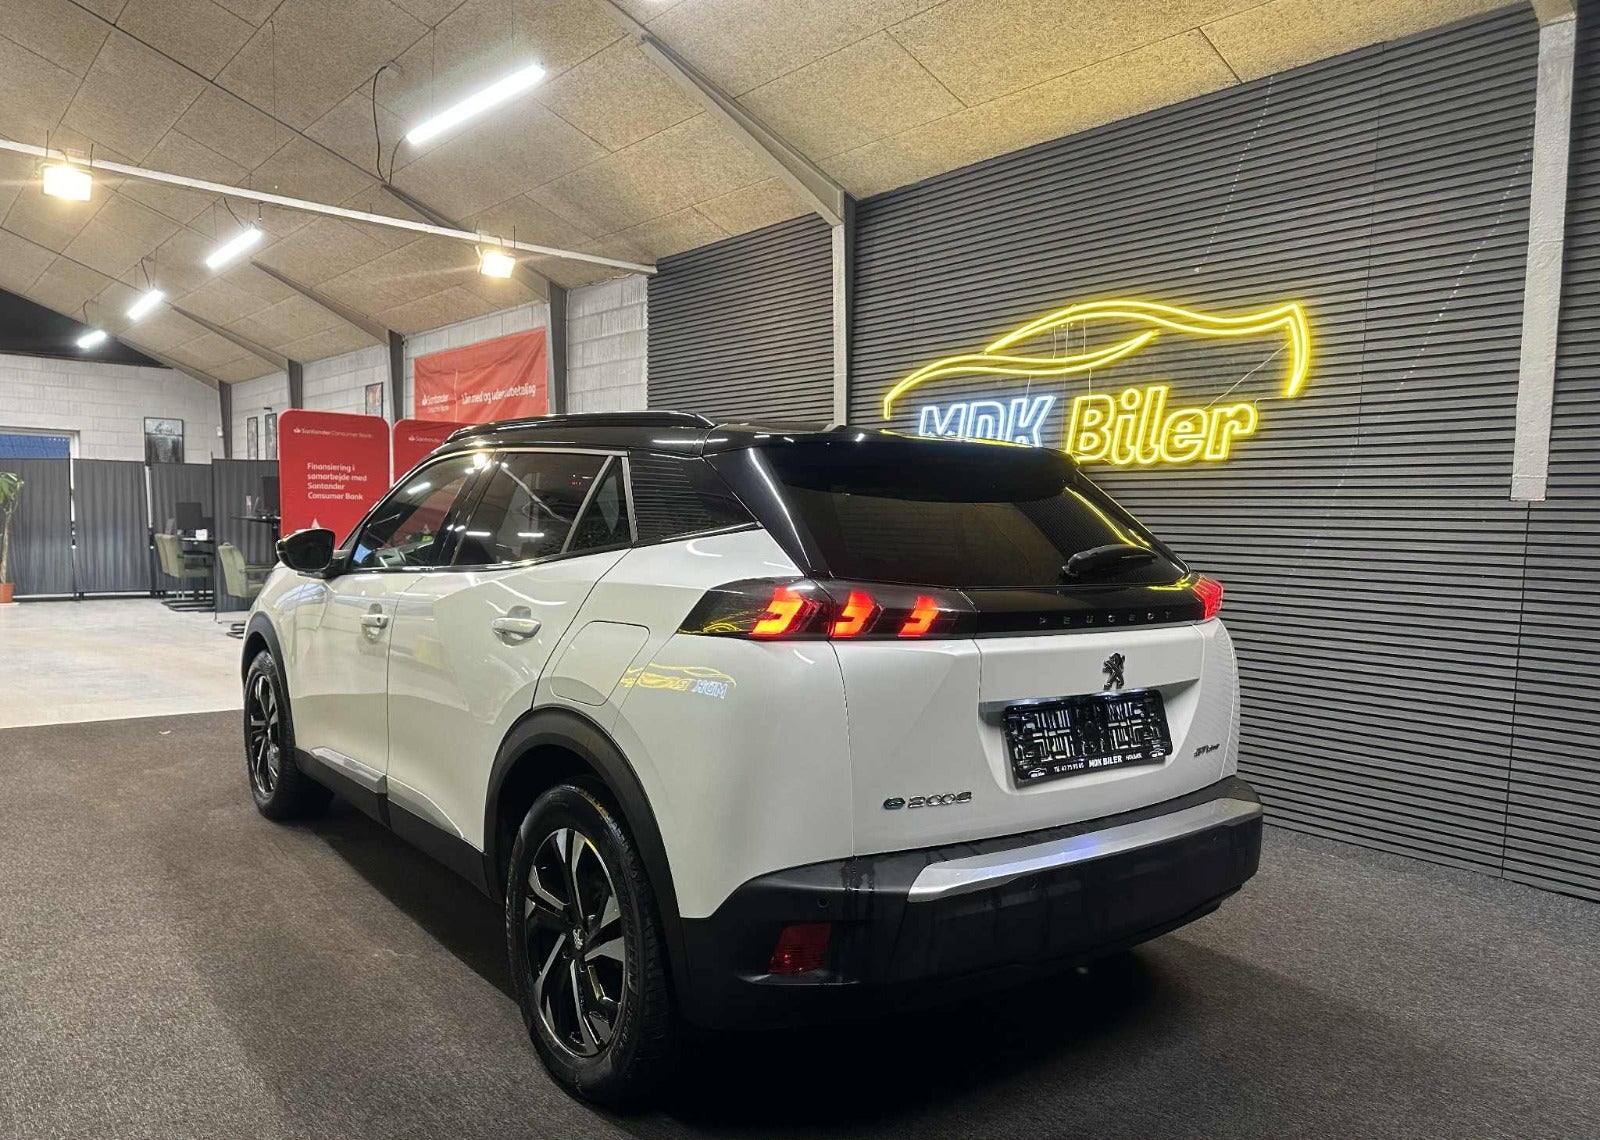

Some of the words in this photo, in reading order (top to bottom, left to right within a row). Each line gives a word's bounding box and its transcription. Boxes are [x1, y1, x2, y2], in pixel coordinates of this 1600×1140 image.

[483, 391, 492, 404] og
[918, 395, 1055, 448] MDK
[1066, 385, 1260, 466] Biler
[301, 427, 331, 435] Santander
[331, 430, 358, 438] Consumer
[307, 462, 351, 473] Finansiering
[307, 473, 350, 482] samarbejde
[307, 482, 345, 490] Santander
[307, 491, 344, 500] Consumer
[345, 492, 363, 500] Bank
[1038, 611, 1172, 625] PEUGEOT
[1102, 755, 1123, 766] BILER
